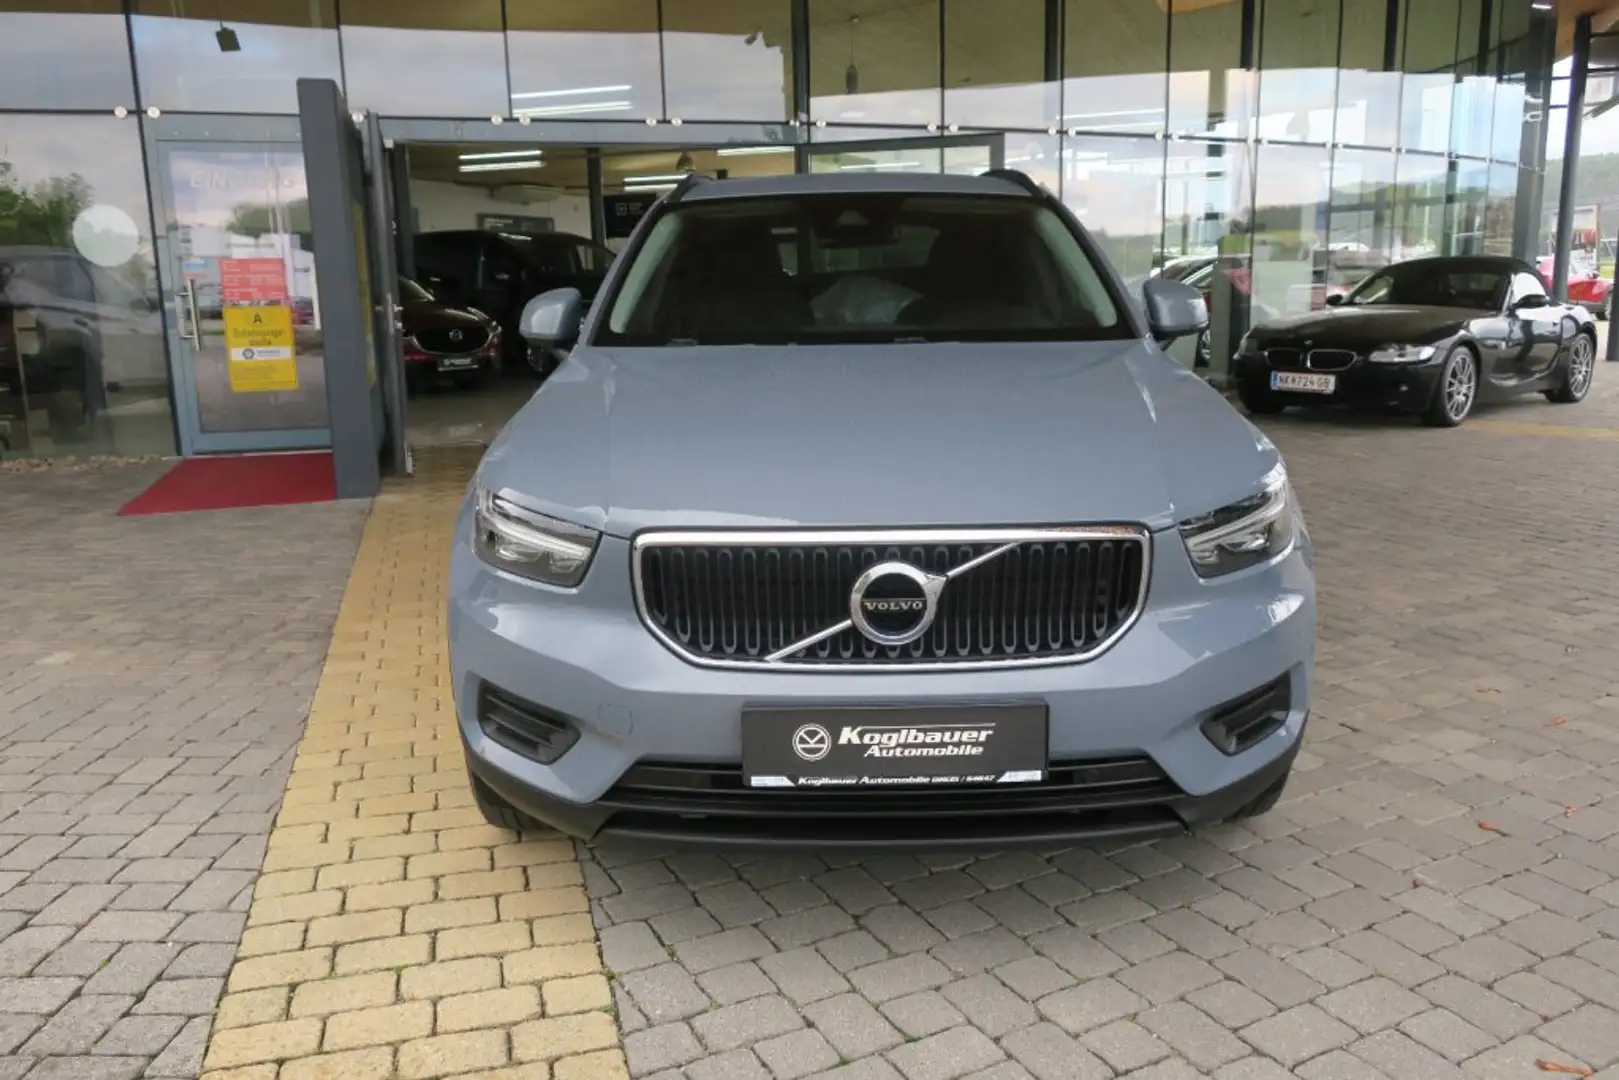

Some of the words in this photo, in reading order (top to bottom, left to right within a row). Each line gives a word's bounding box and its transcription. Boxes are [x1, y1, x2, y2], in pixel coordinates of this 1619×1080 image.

[864, 601, 923, 610] VOLVO
[838, 725, 995, 748] Koglbauer
[863, 743, 984, 758] Automobile
[797, 776, 857, 786] Koglbauer
[859, 775, 930, 784] Automobile
